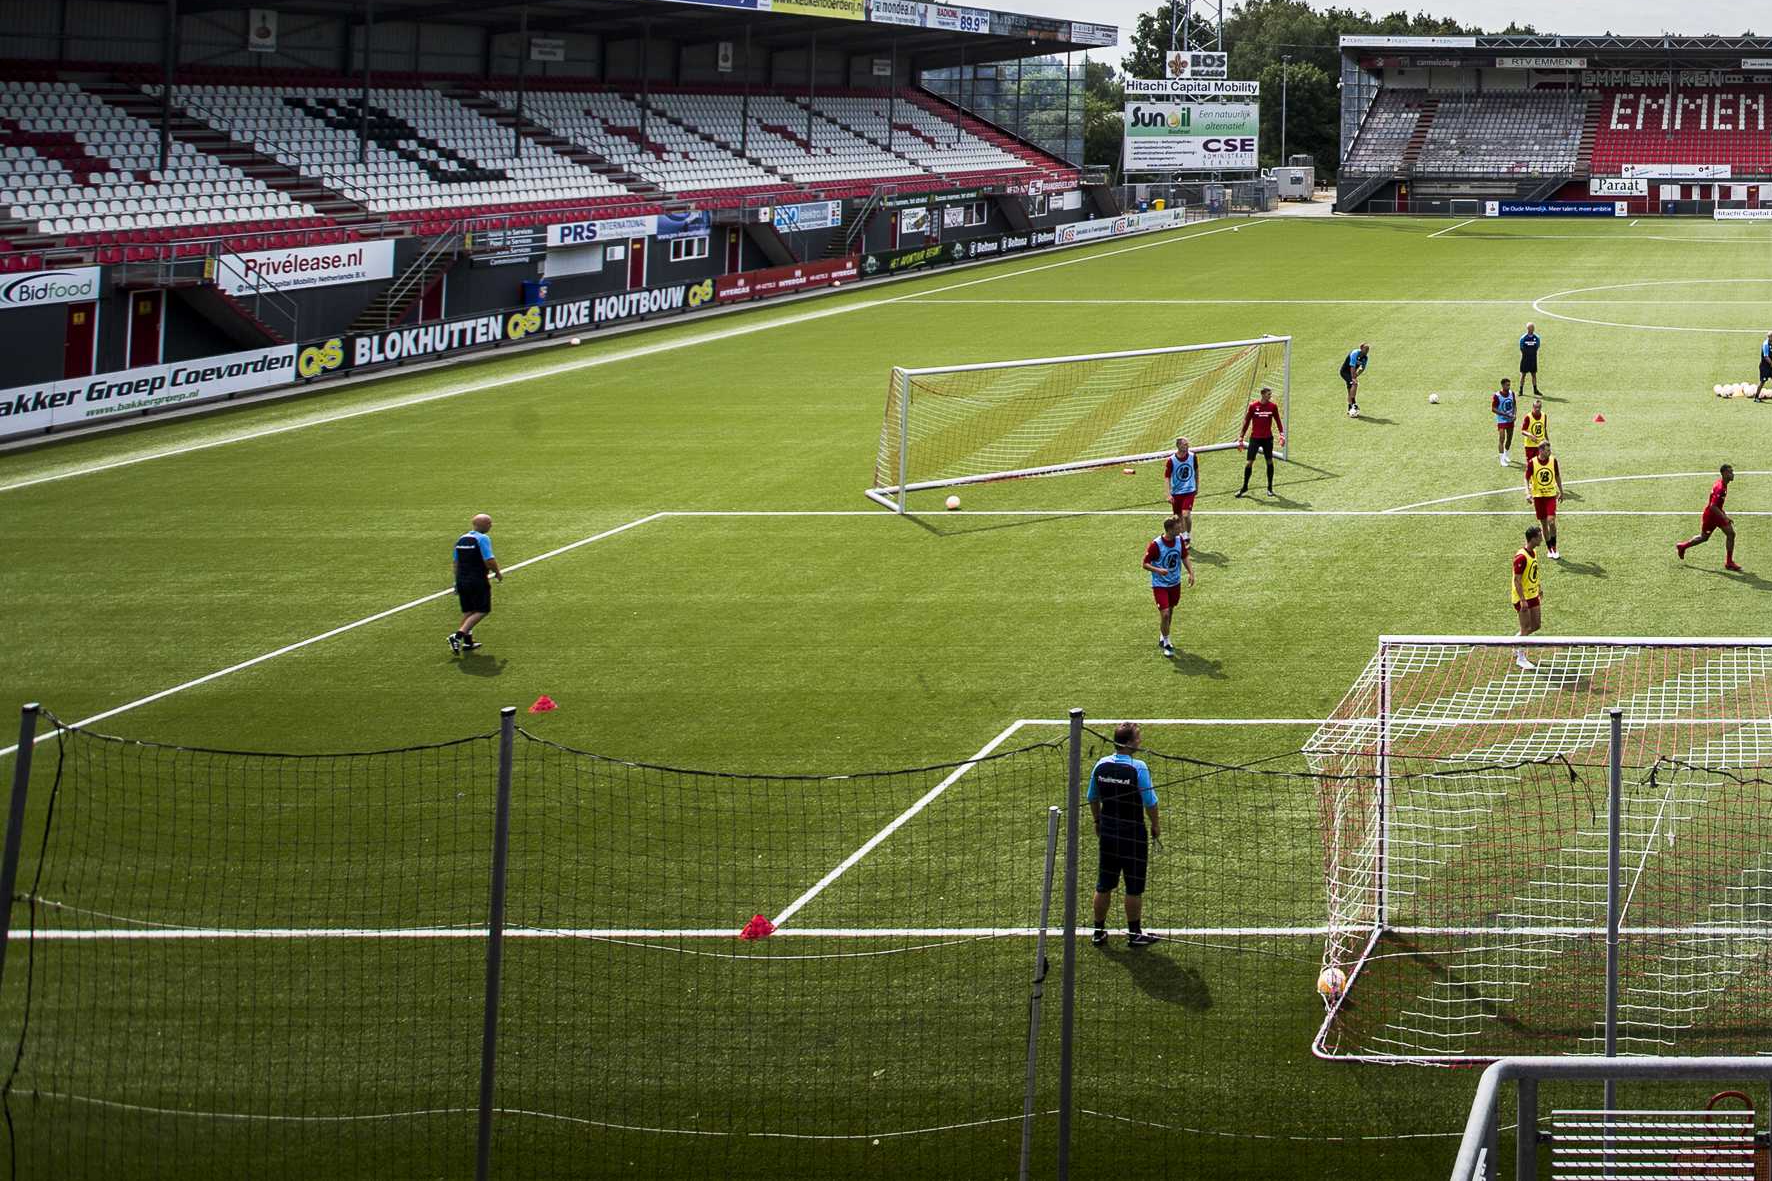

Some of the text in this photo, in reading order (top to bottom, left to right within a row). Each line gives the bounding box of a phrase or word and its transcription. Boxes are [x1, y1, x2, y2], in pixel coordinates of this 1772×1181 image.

[960, 16, 980, 31] 89.9
[1512, 58, 1572, 66] RTV EMMEN
[1126, 81, 1257, 94] Hitachi Capital Mobility
[1200, 109, 1251, 120] Een natuurlijk
[1610, 94, 1764, 130] EMMEN
[1205, 122, 1246, 131] alternatief
[1202, 139, 1254, 152] CSE
[1599, 179, 1640, 191] Paraat
[1743, 210, 1770, 219] Capital
[560, 222, 597, 243] PRS
[244, 249, 363, 278] Privélease.nl
[293, 276, 318, 286] Mobility
[319, 273, 354, 283] Netherlands
[19, 279, 92, 301] Bidfood
[354, 315, 502, 367] BLOKHUTTEN
[545, 300, 590, 331] LUXE
[594, 286, 685, 321] HOUTBOUW
[0, 353, 293, 417] akker Groep Coevorden
[86, 389, 199, 416] www.bakkergroep.nl
